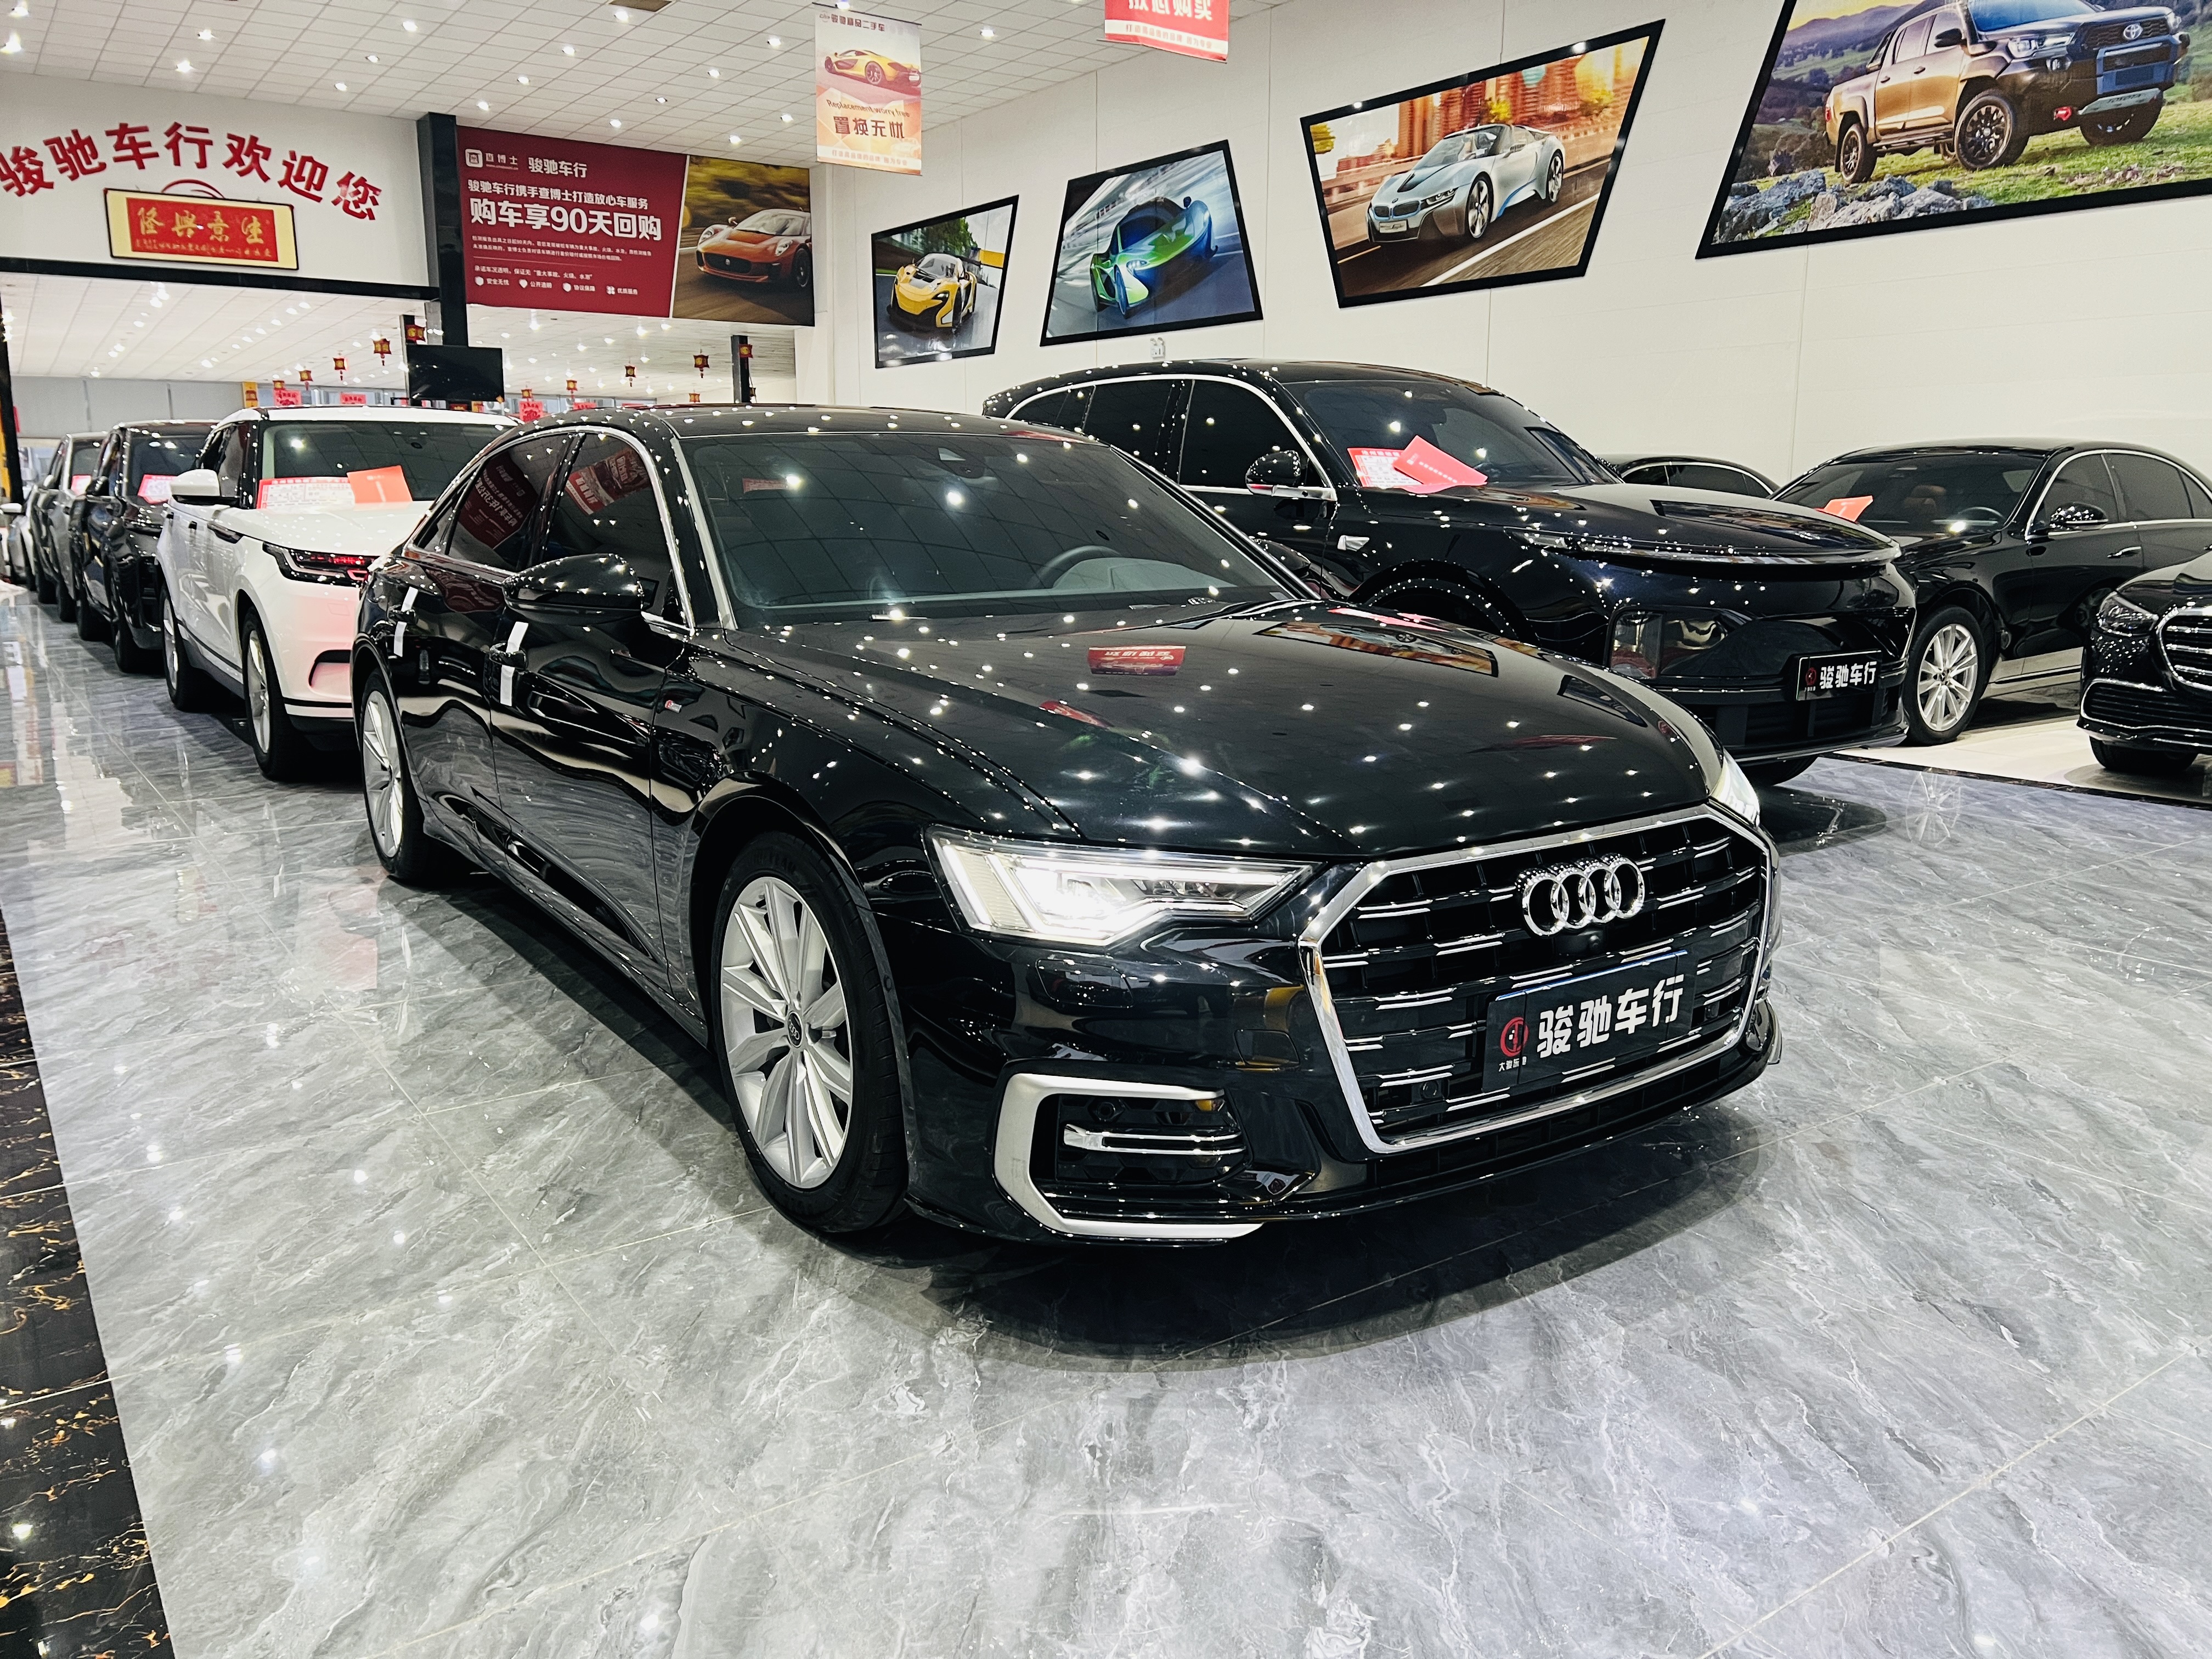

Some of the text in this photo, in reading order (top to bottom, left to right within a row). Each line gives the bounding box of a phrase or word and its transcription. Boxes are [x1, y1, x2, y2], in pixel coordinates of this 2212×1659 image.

[826, 99, 910, 117] Replacement worry free
[833, 116, 905, 138] 置换无忧
[0, 122, 382, 221] 骏驰车行欢迎您
[528, 157, 587, 178] 骏驰车行
[468, 180, 648, 210] 骏驰车行携手查博士打造放心车服务
[470, 198, 662, 240] 购车享90天回购
[1819, 661, 1877, 689] 骏驰车行
[1537, 974, 1684, 1058] 骏驰车行
